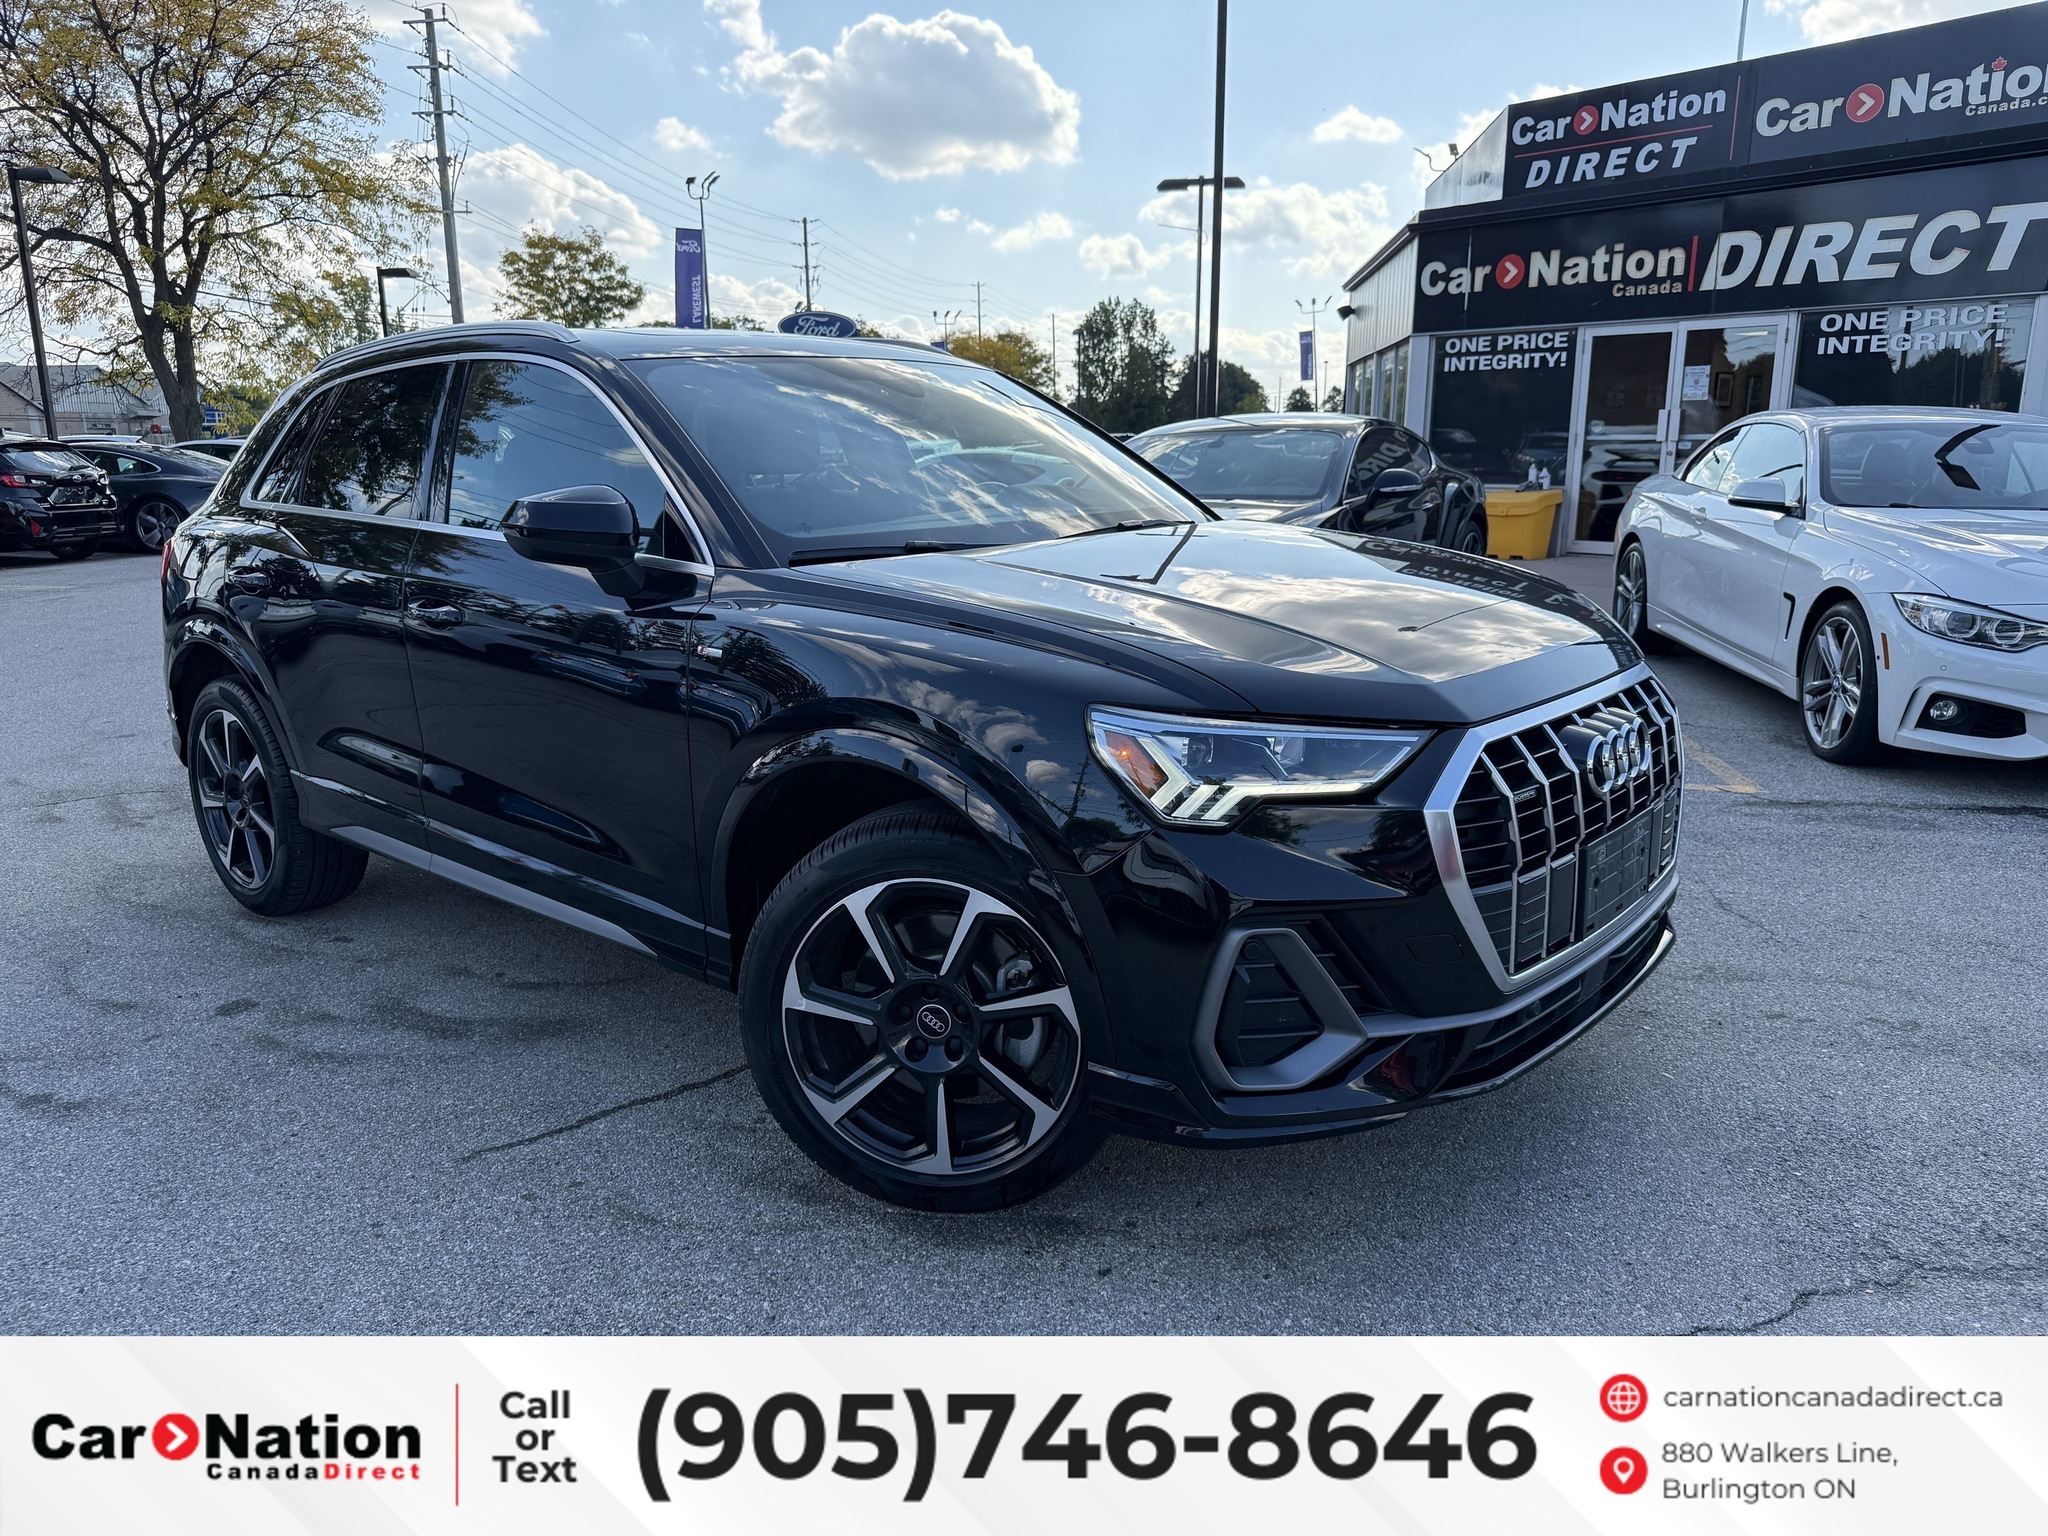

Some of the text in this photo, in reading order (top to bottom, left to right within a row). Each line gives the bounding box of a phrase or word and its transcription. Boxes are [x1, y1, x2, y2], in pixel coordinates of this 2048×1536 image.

[1756, 58, 2048, 137] Car Natio
[1511, 89, 1727, 146] Car Nation
[1525, 137, 1698, 189] DIRECT
[1420, 201, 2048, 296] Car Nation DIRECT
[1612, 280, 1683, 297] Canada
[794, 315, 841, 337] Ford
[1819, 303, 2010, 333] ONE PRICE
[1445, 331, 1569, 354] ONE PRICE
[1817, 328, 2005, 355] INTEGRITY!
[1443, 351, 1568, 372] INTEGRITY!
